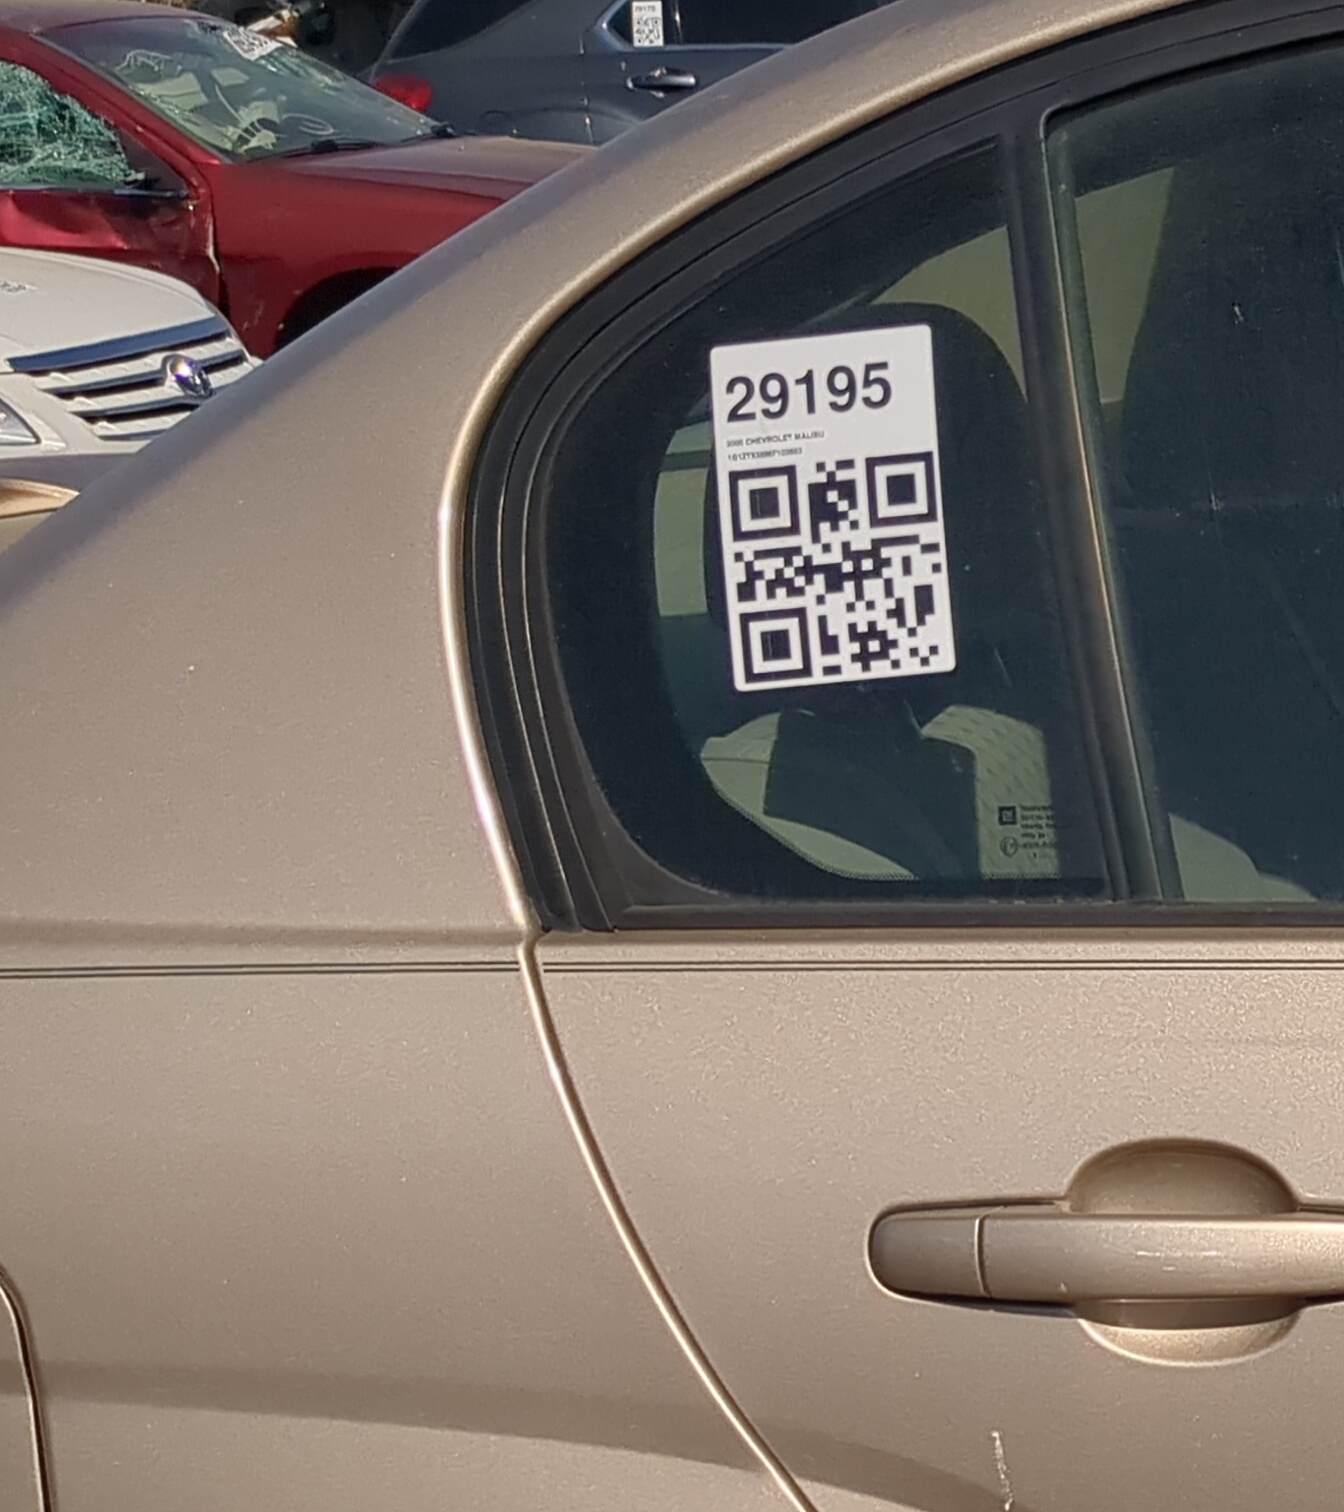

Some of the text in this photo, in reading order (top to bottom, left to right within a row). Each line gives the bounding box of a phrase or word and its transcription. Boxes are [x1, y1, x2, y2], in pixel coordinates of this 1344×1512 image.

[725, 361, 893, 423] 29195
[745, 434, 793, 446] CHEVROLET
[794, 431, 825, 440] MALIBU
